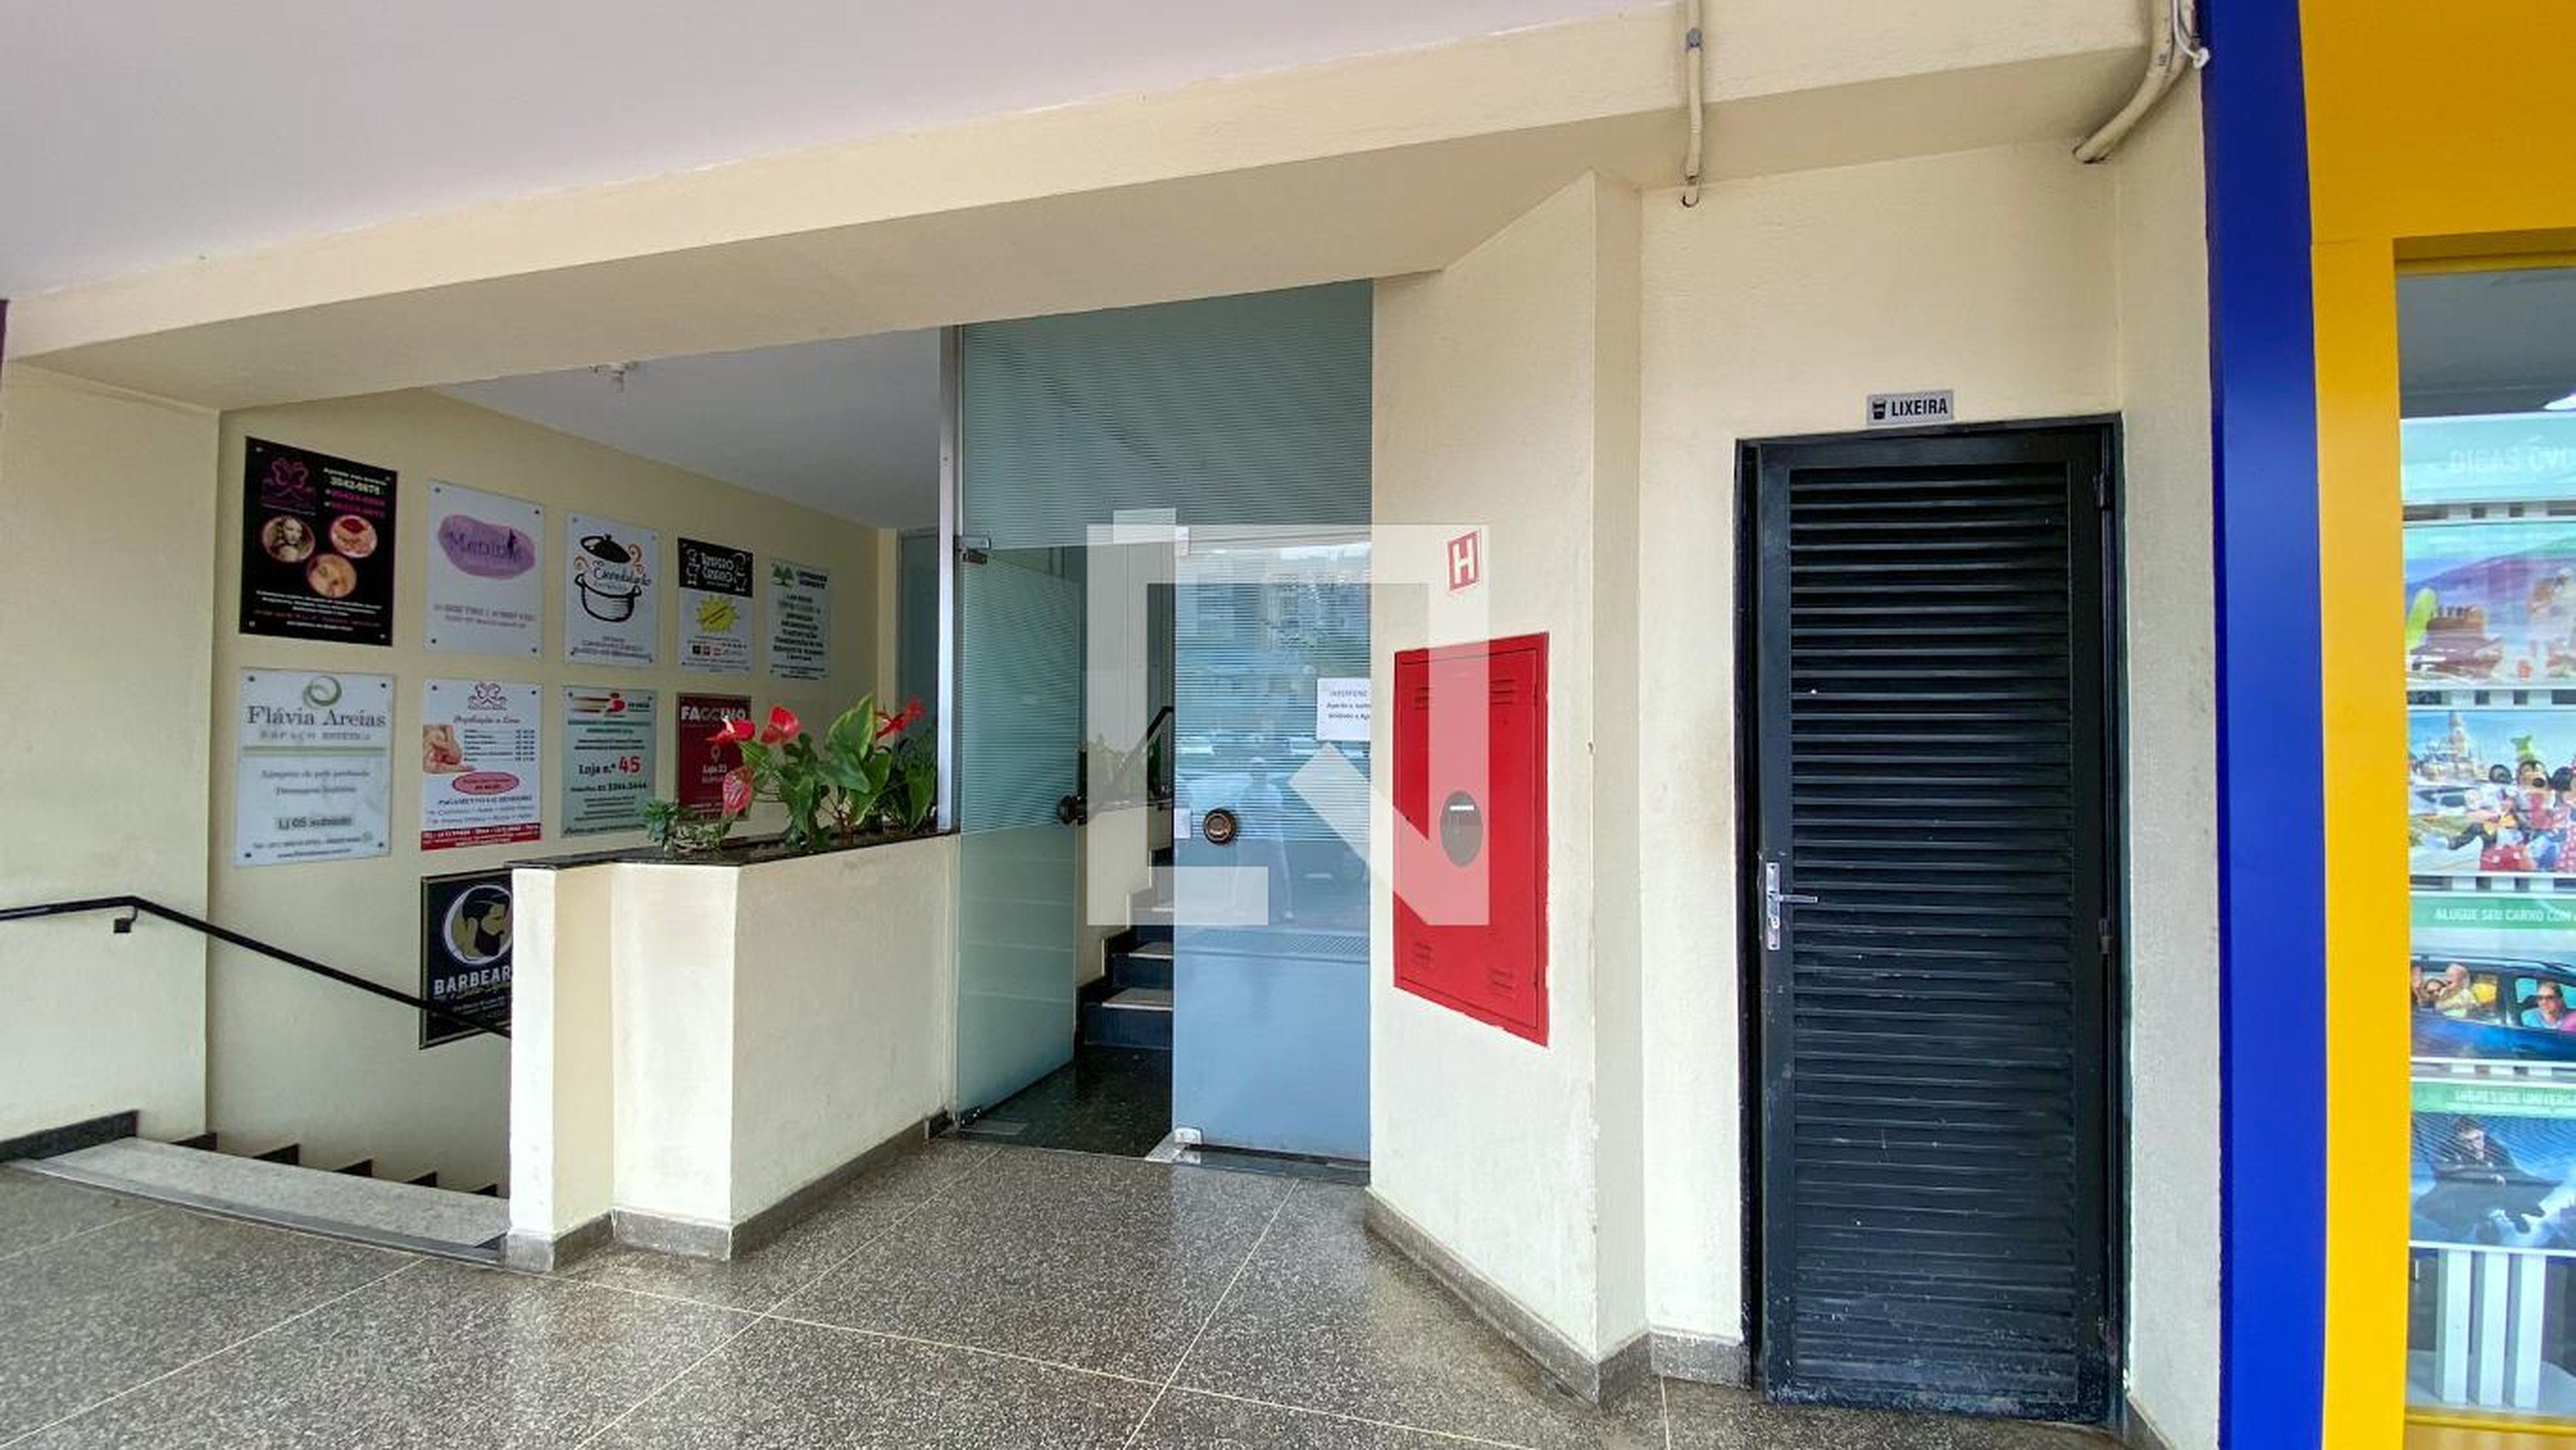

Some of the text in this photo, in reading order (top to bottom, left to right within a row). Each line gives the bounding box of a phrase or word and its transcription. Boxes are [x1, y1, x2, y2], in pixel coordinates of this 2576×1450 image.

[1892, 398, 1948, 417] LIXEIRA
[1454, 538, 1475, 584] H
[247, 705, 386, 727] Flávia Areias
[579, 762, 601, 777] Loja
[619, 755, 641, 774] 45
[2434, 908, 2571, 922] ALUGUE SEU CARRO COM
